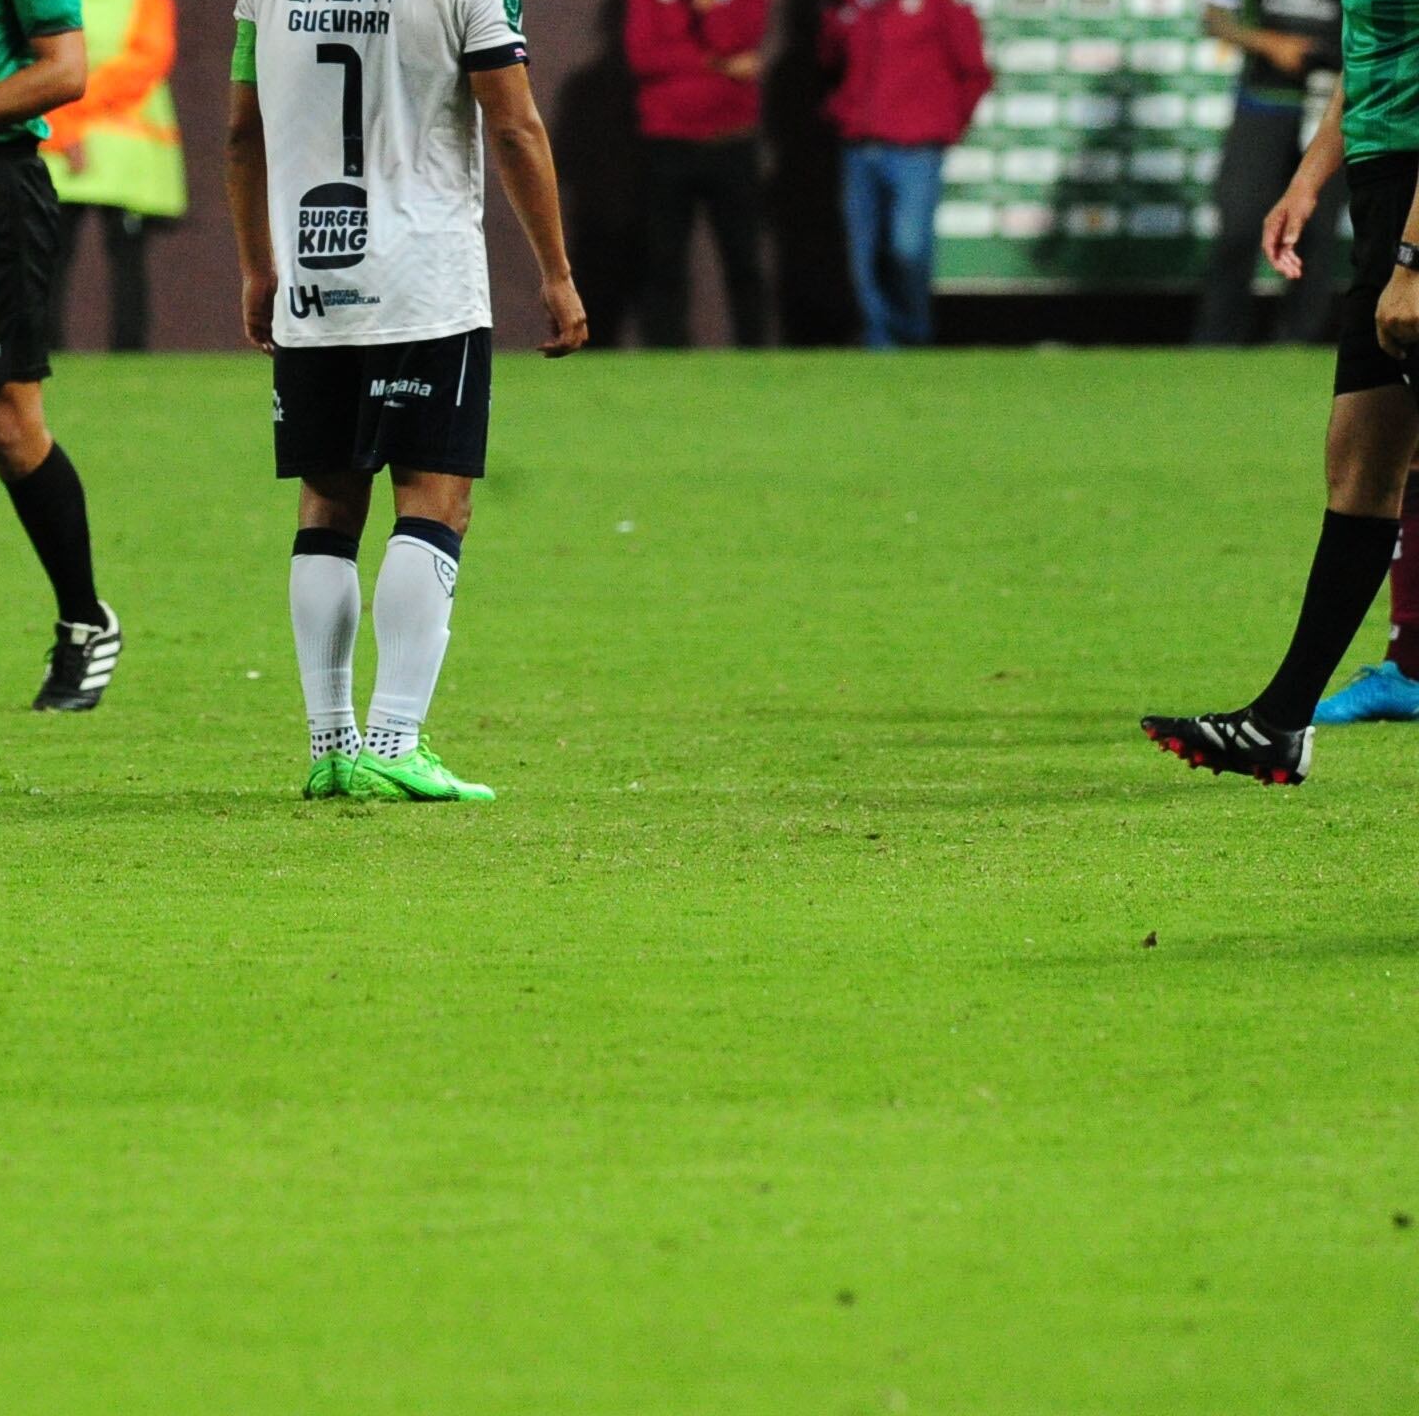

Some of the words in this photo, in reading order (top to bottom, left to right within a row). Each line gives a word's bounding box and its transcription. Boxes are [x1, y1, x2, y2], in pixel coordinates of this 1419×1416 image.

[288, 9, 390, 35] GUEVARA
[316, 43, 363, 177] 7
[298, 209, 368, 228] BURGER
[298, 228, 368, 255] KING
[289, 284, 325, 319] UH
